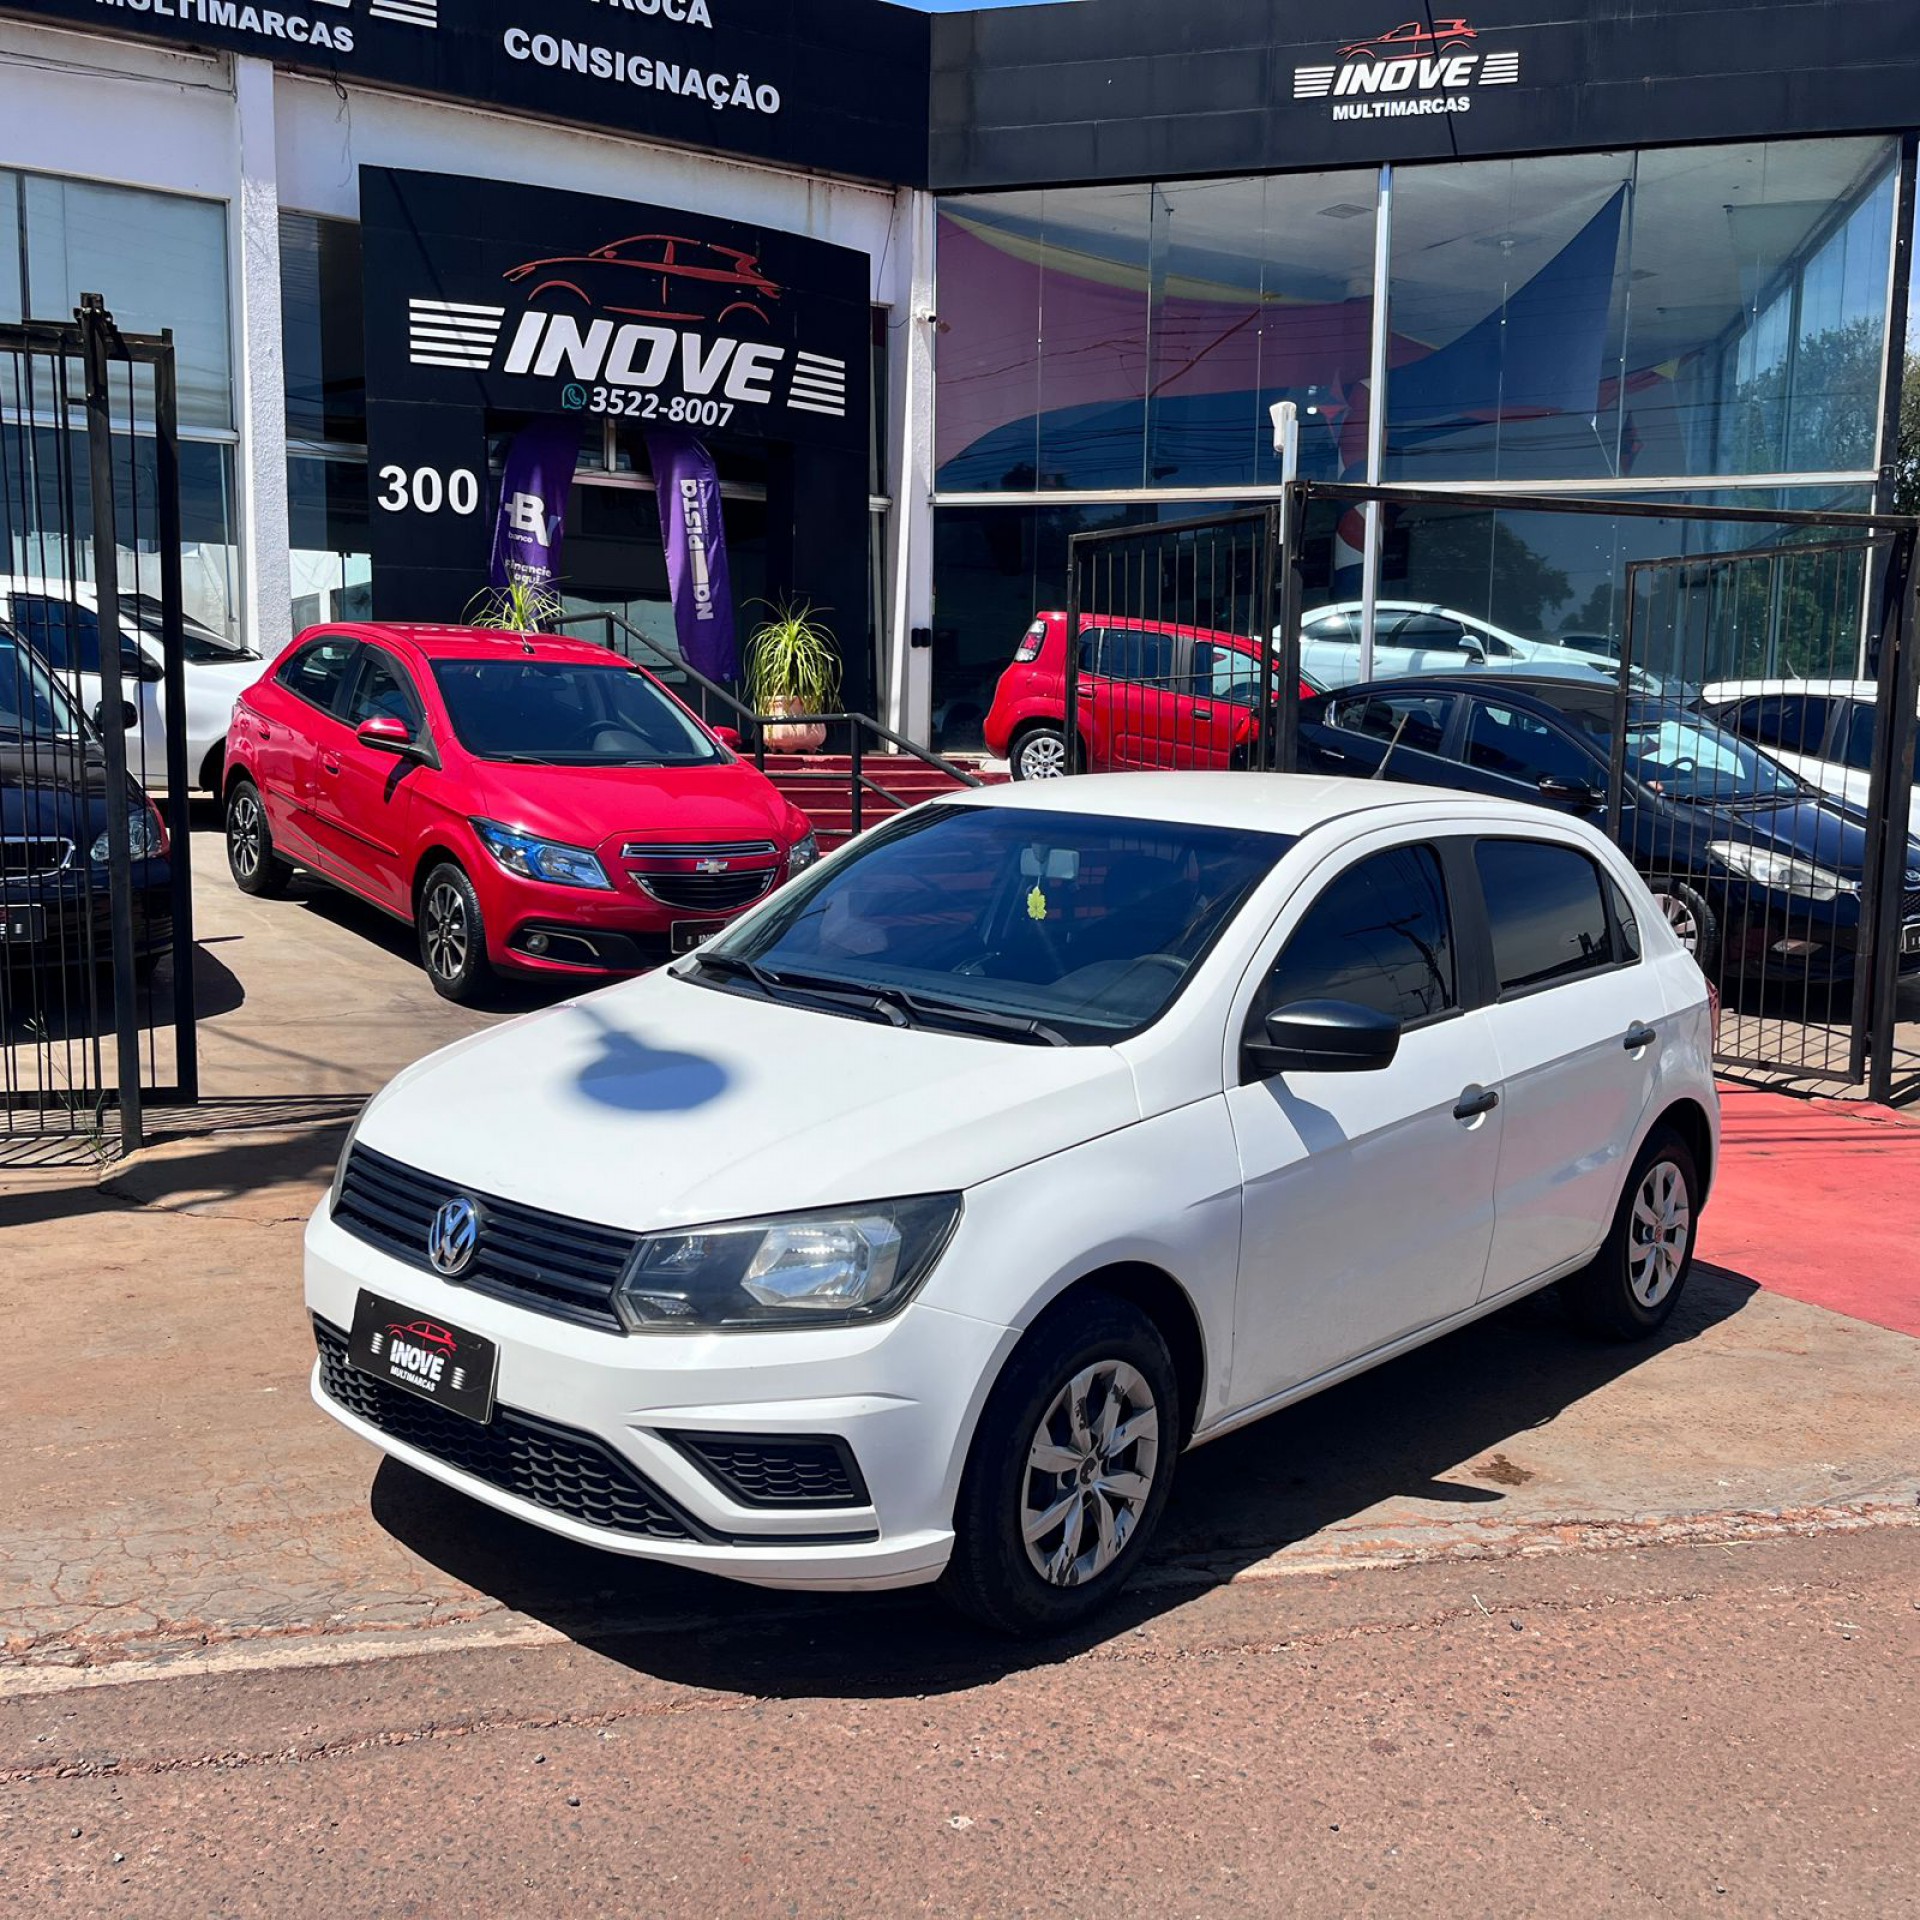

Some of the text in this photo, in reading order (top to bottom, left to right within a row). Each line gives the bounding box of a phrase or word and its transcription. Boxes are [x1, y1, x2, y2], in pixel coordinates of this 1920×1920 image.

[97, 0, 355, 52] LTIMARCAS
[504, 28, 780, 114] CONSIGNAÇÃO
[1333, 55, 1479, 95] INOVE
[1333, 97, 1470, 120] MULTIMARCAS
[504, 311, 785, 404] INOVE
[589, 386, 734, 427] 3522-8007
[377, 465, 478, 514] 300
[508, 531, 534, 543] banco
[390, 1339, 445, 1382] INOVE
